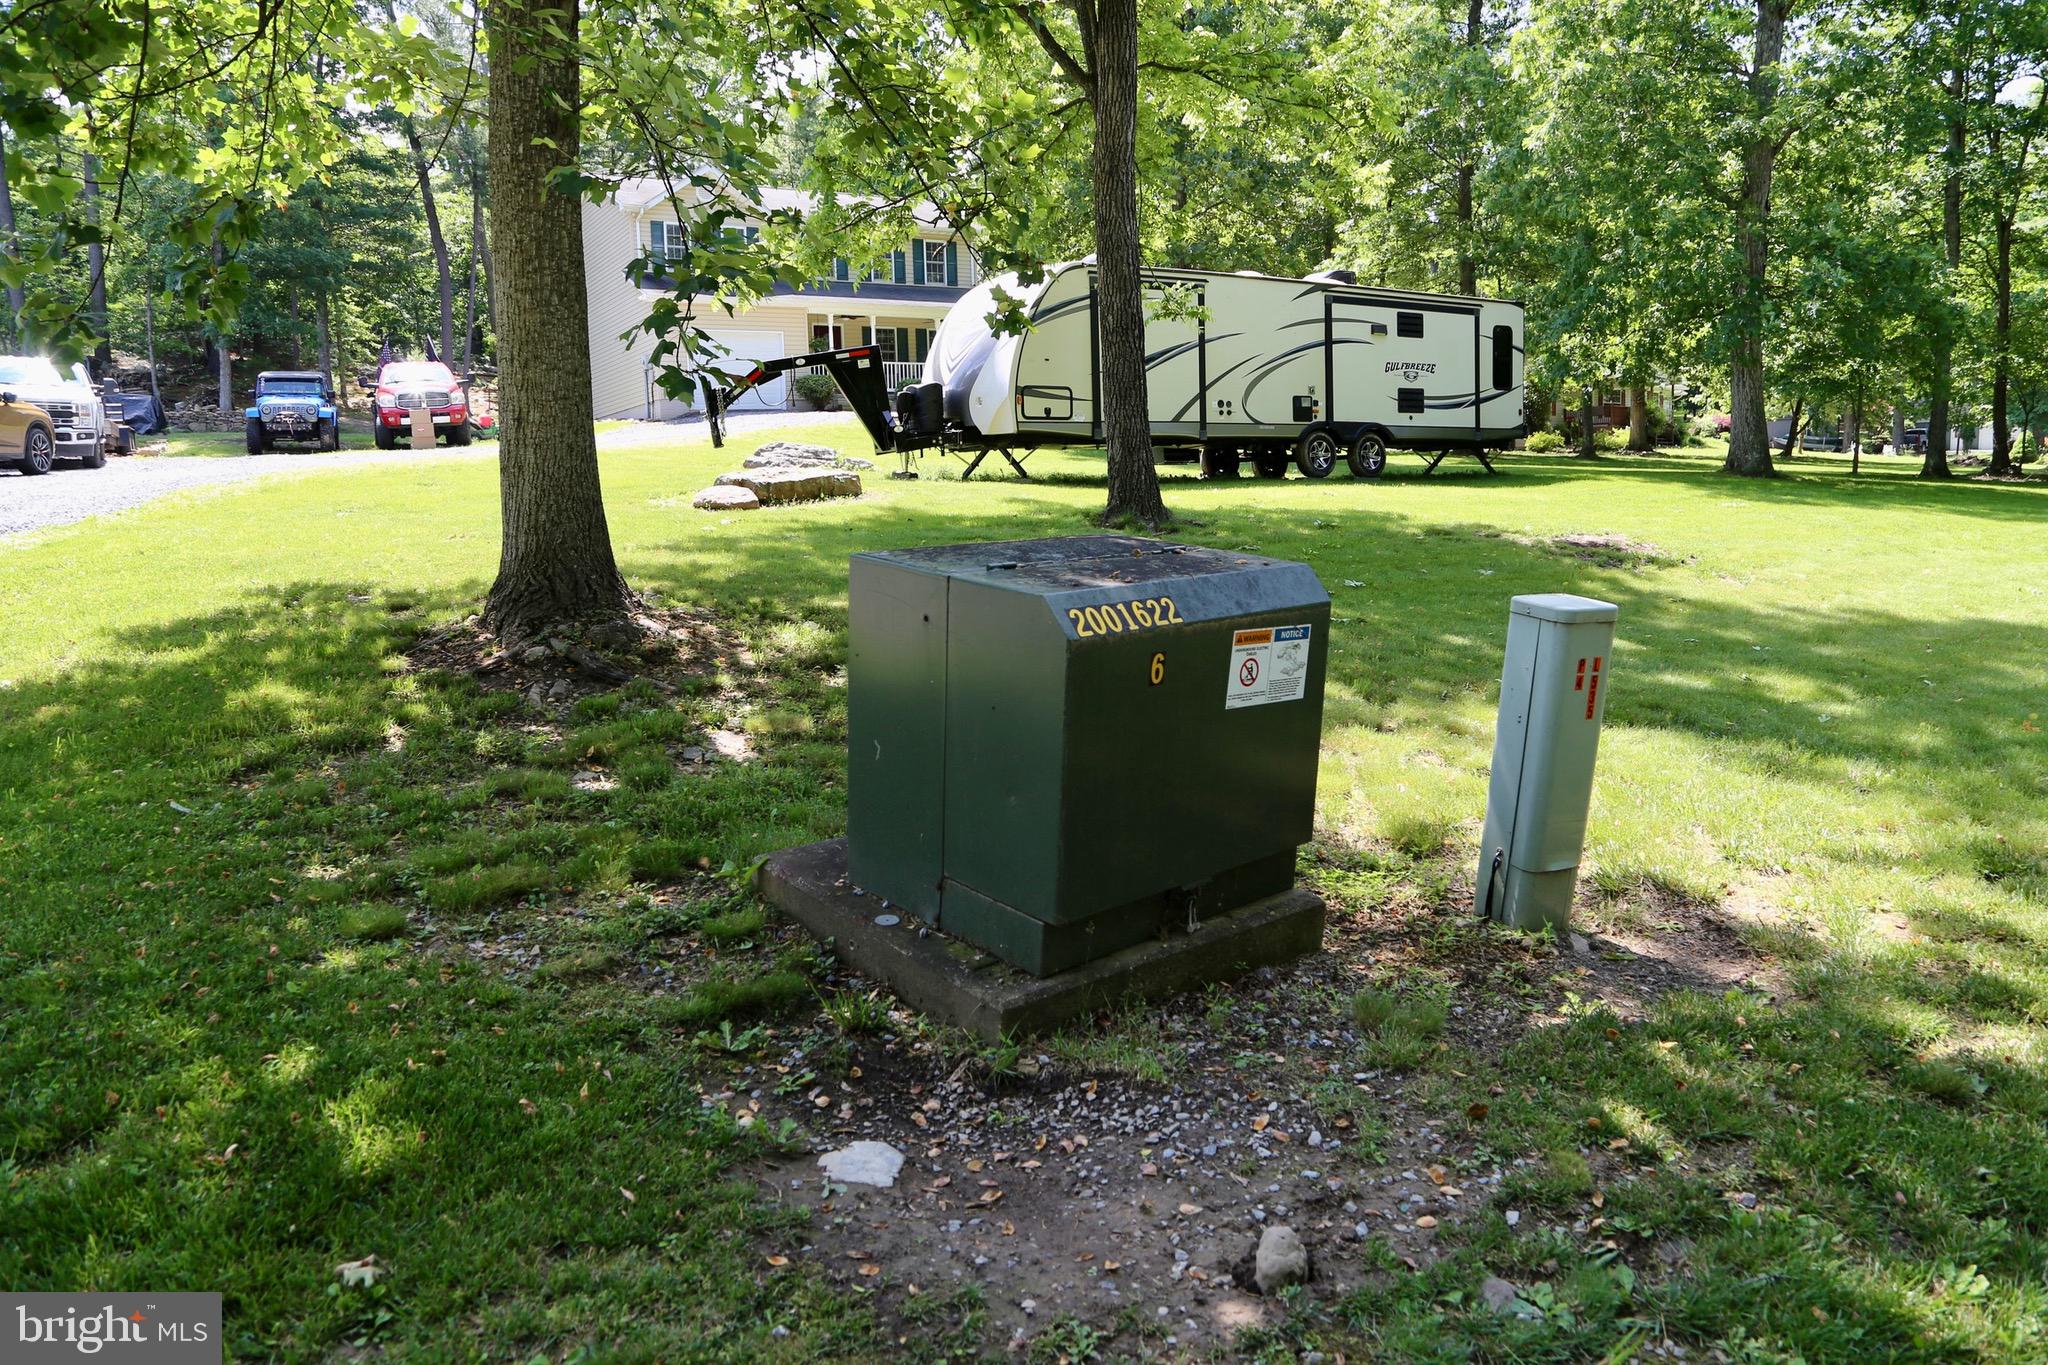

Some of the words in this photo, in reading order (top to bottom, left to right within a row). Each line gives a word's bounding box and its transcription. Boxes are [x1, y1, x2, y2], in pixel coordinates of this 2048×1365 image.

[1385, 362, 1436, 374] GULFBREEZE
[1069, 597, 1184, 637] 2001622
[1243, 633, 1270, 642] WARNING
[1280, 629, 1304, 640] NOTICE
[1151, 653, 1165, 684] 6
